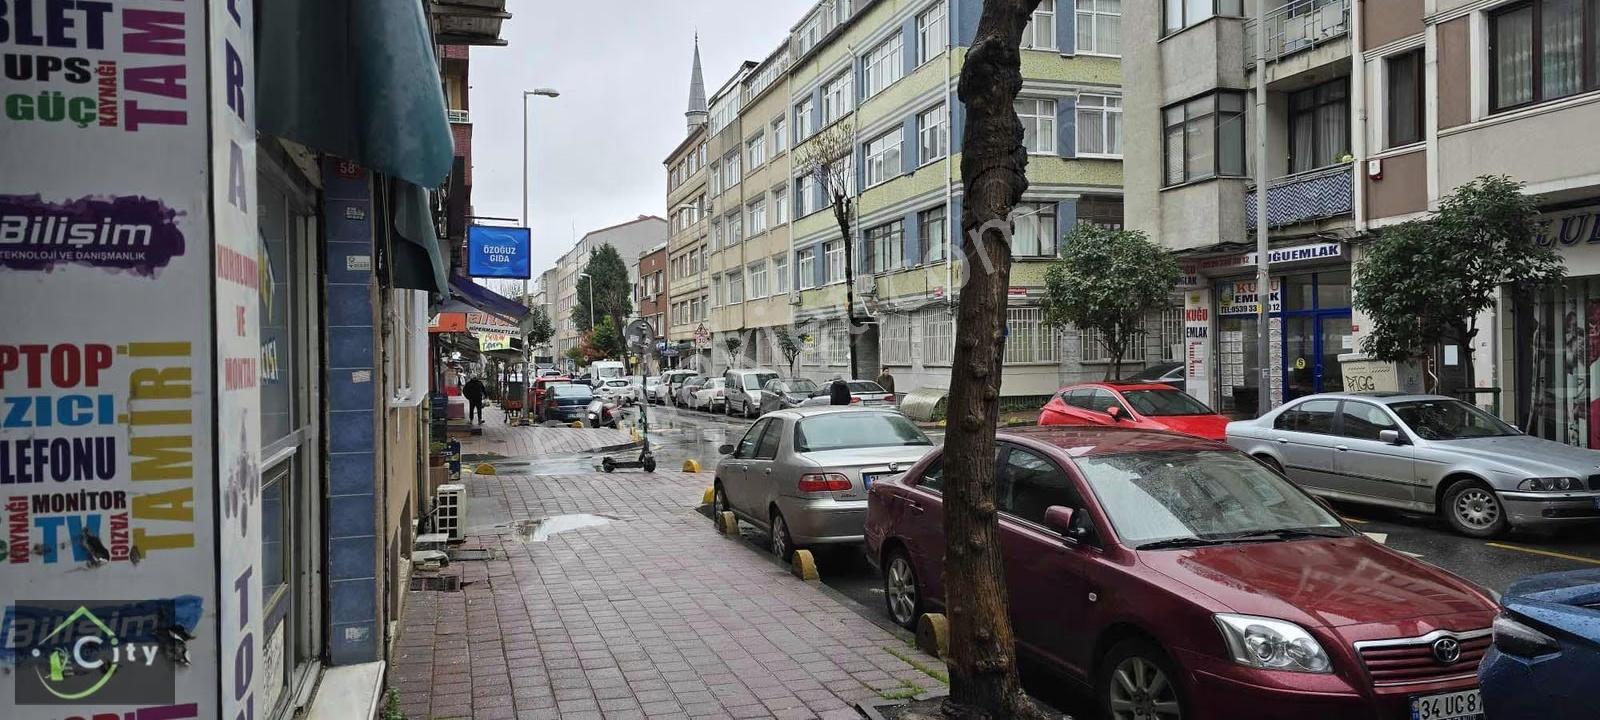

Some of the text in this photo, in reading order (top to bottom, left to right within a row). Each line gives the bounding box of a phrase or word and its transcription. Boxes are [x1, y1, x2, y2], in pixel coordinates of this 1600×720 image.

[4, 53, 92, 84] UPS
[94, 60, 118, 127] KAYNAĞI
[5, 90, 97, 129] GÜÇ
[0, 215, 152, 248] Bilişim
[60, 251, 73, 260] VE
[76, 251, 146, 261] DANIŞMANLIK
[483, 245, 517, 255] ÖZOĞUZ
[490, 254, 510, 263] GIDA
[1255, 245, 1338, 264] UĞUEMLAK
[1235, 281, 1279, 294] KUU
[1186, 307, 1208, 321] KUĞU
[1186, 326, 1208, 339] EMLAK
[116, 341, 195, 559] TAMİRİ
[32, 489, 127, 514] MONİTOR
[4, 496, 30, 564] KAYNAĞI
[34, 514, 102, 564] TV
[110, 512, 129, 562] YAZICI
[1421, 698, 1440, 719] 34
[1446, 695, 1464, 715] UC
